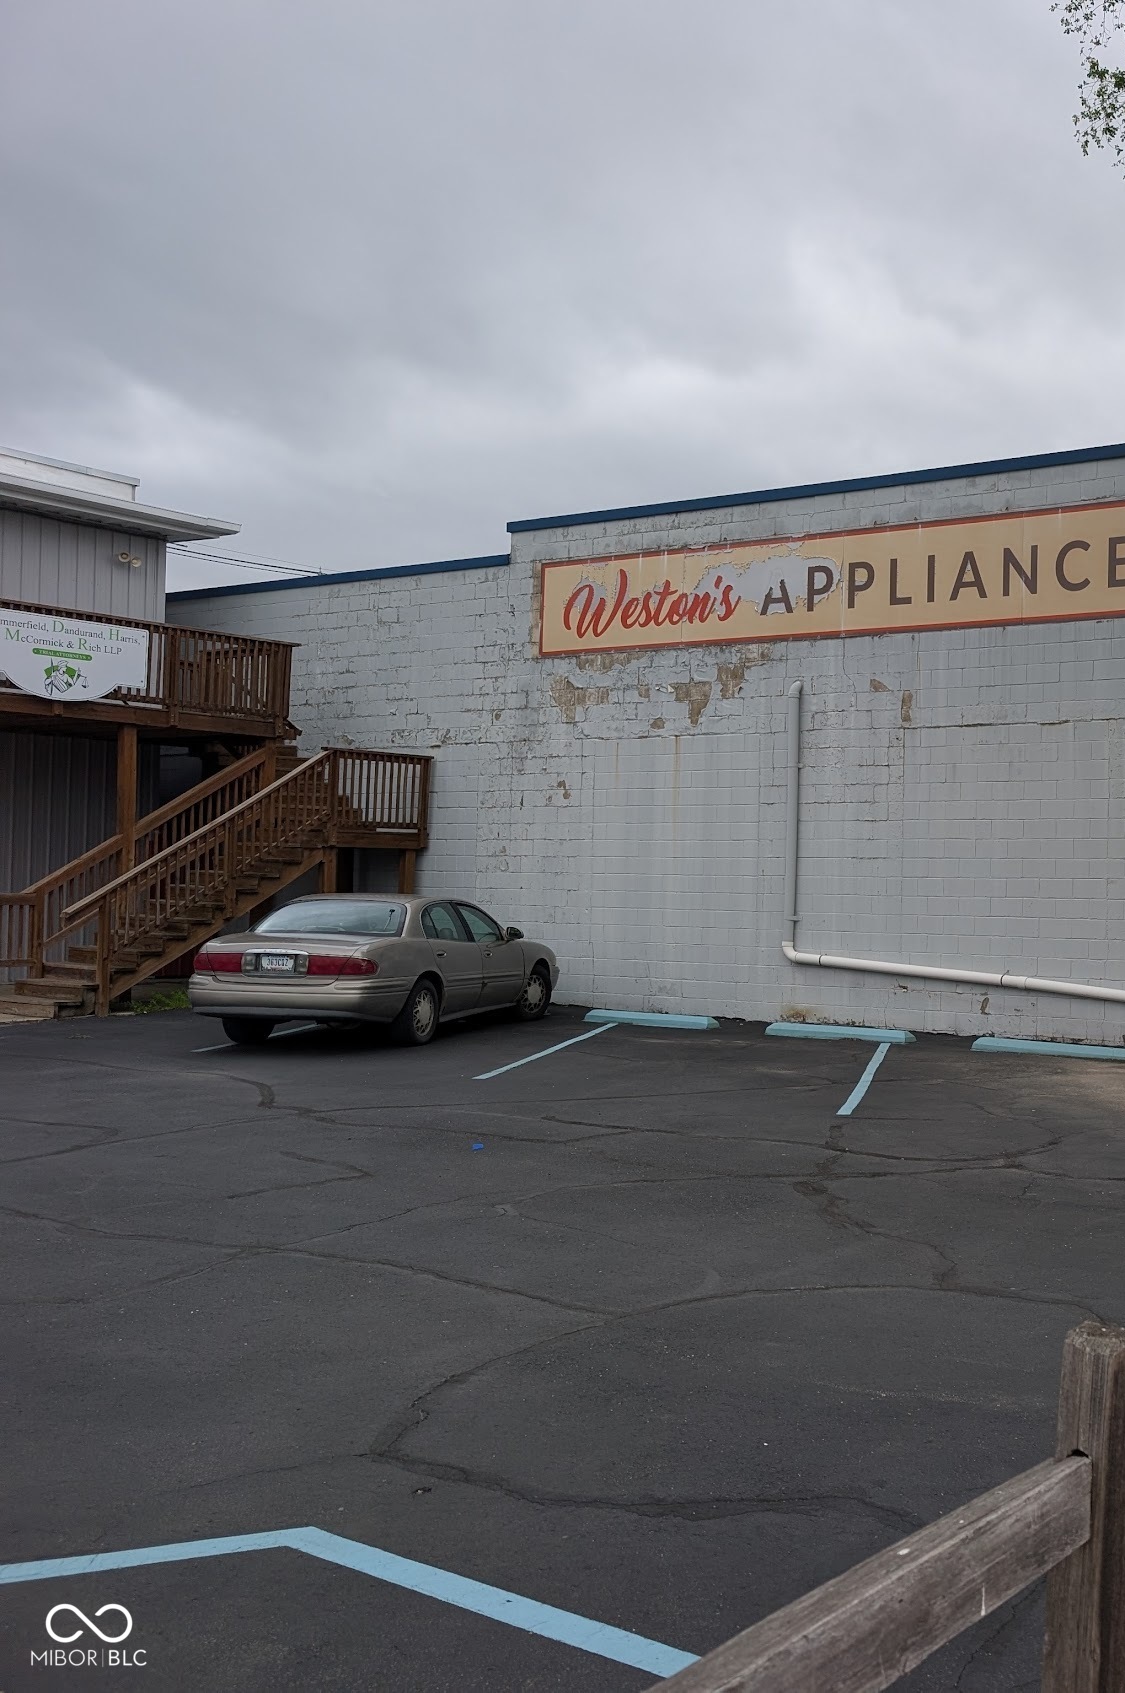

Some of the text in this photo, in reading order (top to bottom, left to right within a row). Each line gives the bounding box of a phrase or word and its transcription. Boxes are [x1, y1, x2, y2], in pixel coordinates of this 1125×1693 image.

[563, 568, 742, 639] Weston's
[5, 627, 123, 655] McCormick & Rich LLP
[52, 620, 106, 640] Dandurand,
[109, 628, 141, 645] Harris,
[57, 651, 88, 660] ATTORNEYS
